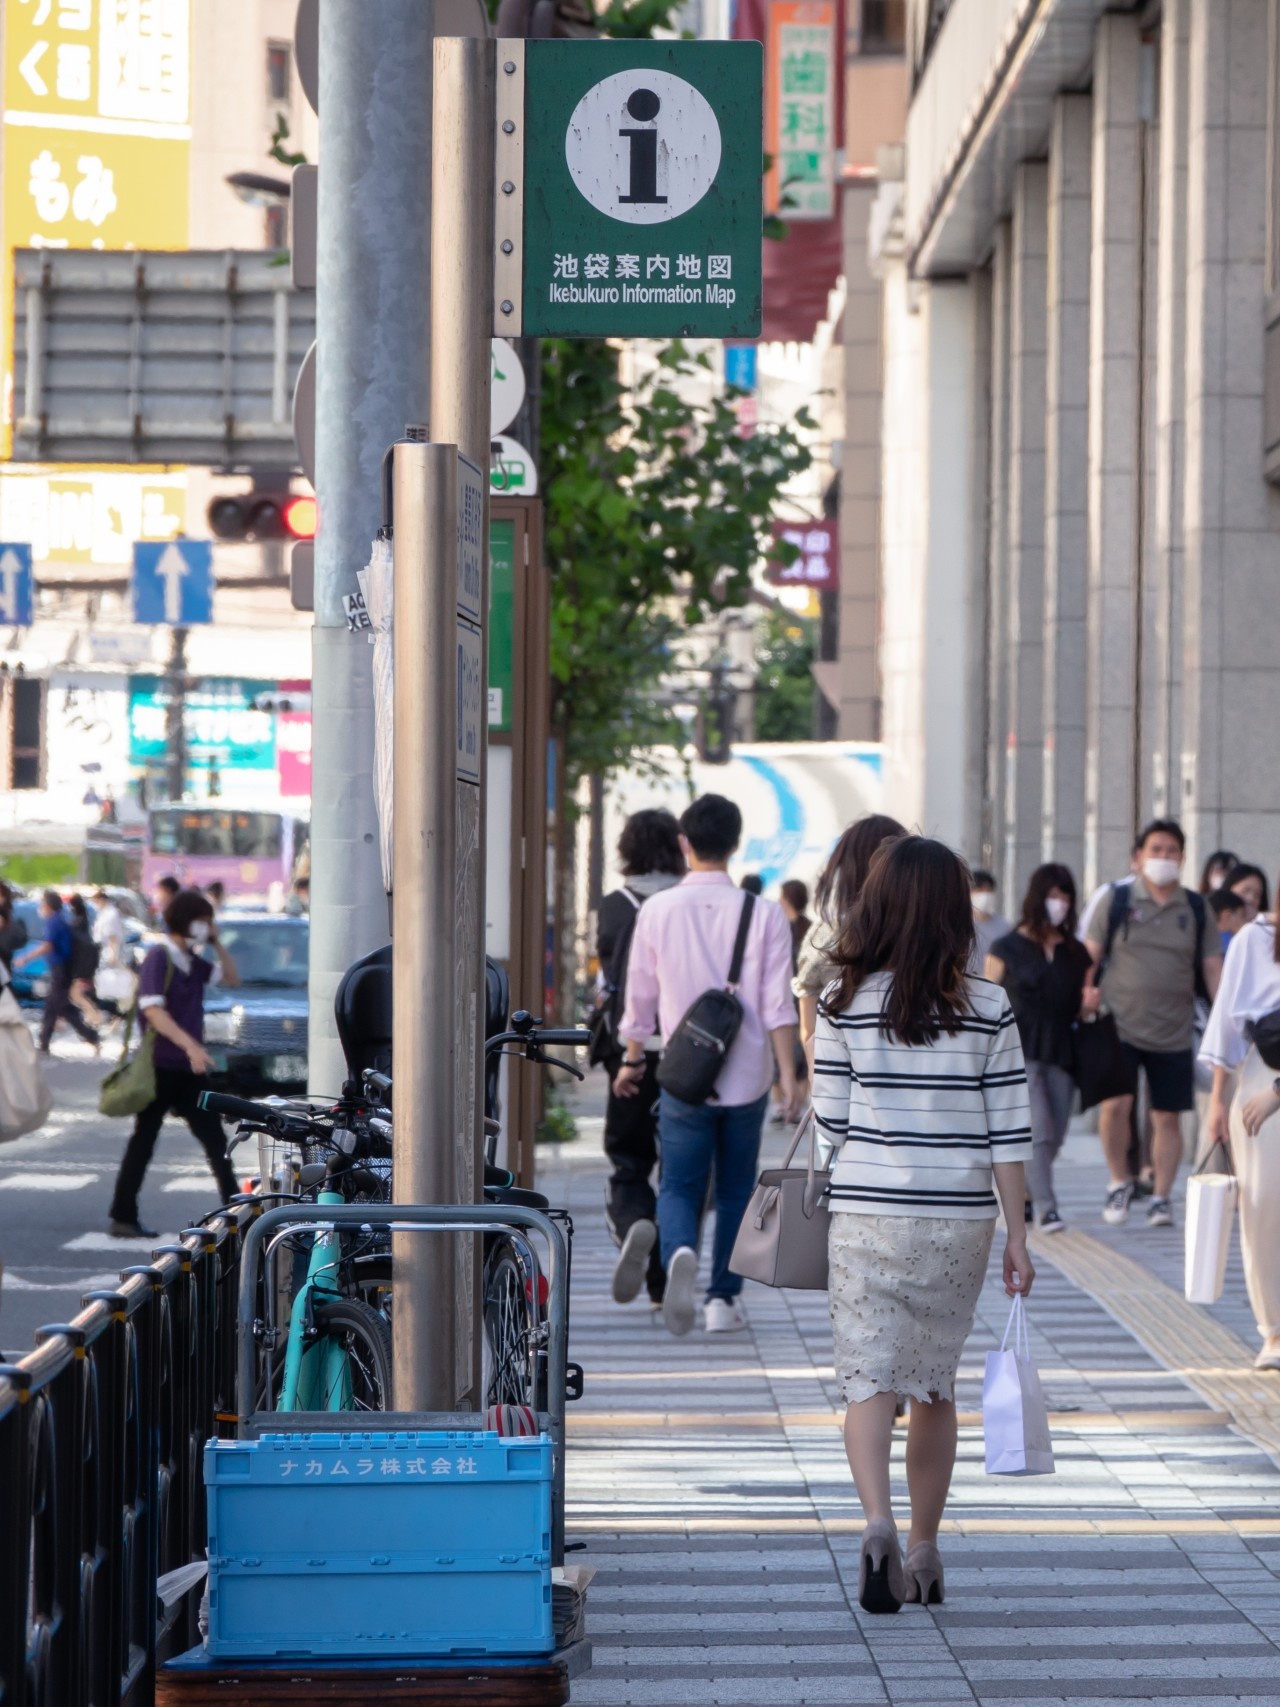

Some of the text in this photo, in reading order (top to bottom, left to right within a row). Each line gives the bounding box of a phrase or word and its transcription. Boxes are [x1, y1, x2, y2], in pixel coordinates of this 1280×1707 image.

[552, 253, 732, 280] 池袋案内地図
[550, 283, 736, 308] Ikebukuro Information Map
[279, 1457, 478, 1477] ナカムラ株式会社
